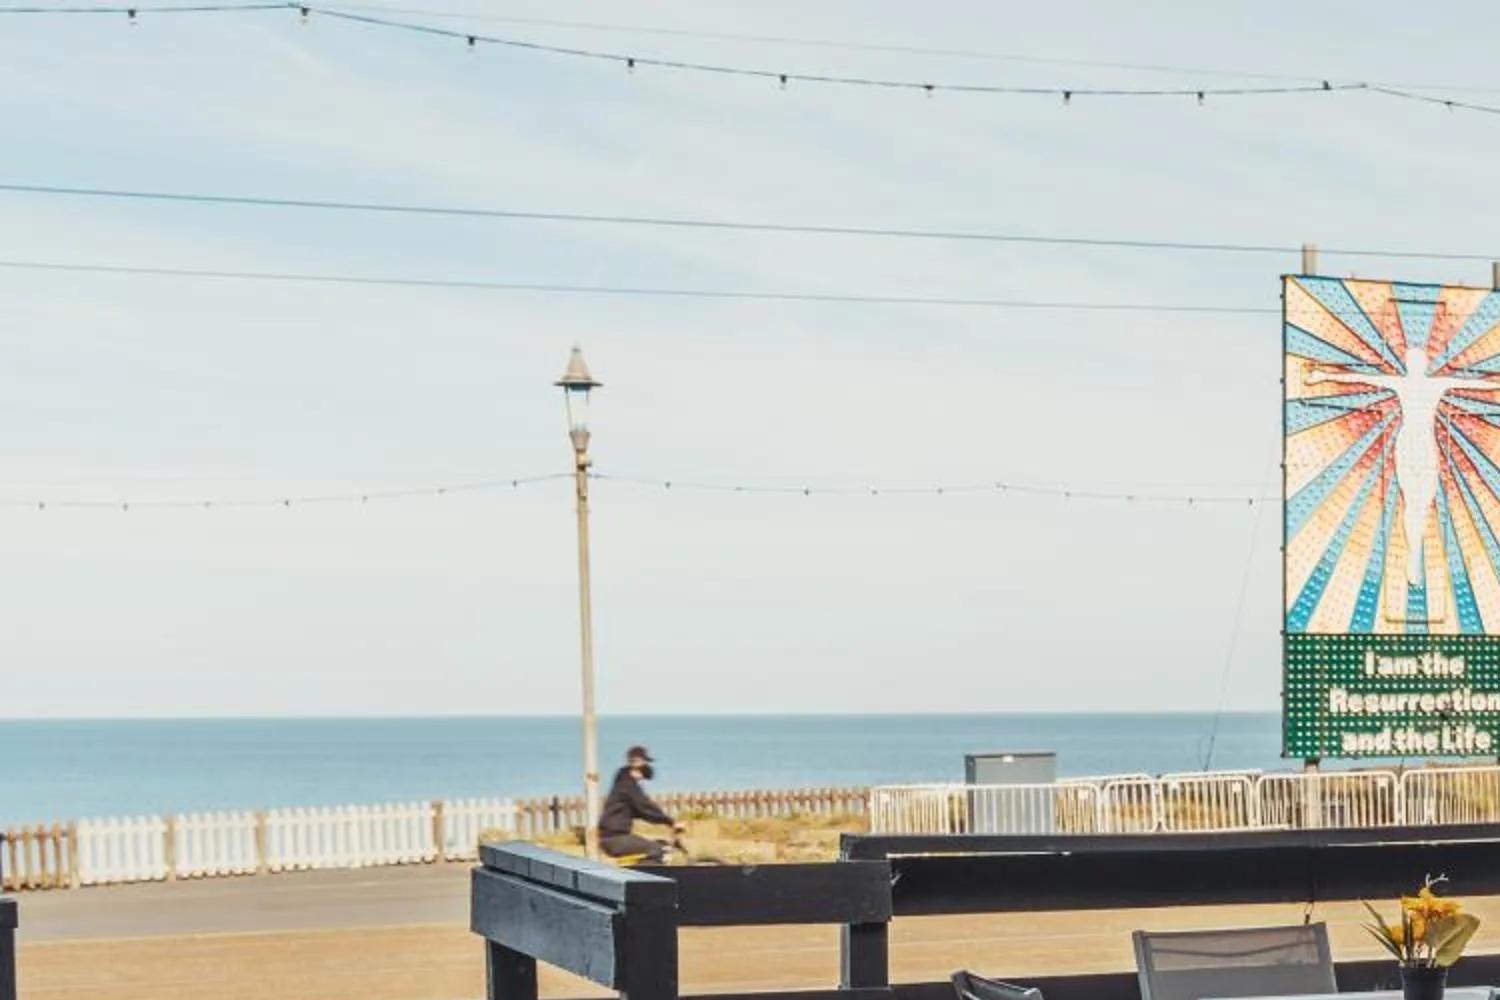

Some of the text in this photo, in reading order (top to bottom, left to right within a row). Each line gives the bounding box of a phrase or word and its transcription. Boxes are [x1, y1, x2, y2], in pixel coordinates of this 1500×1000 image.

[1365, 651, 1465, 675] I am the
[1341, 726, 1492, 751] and the Life
